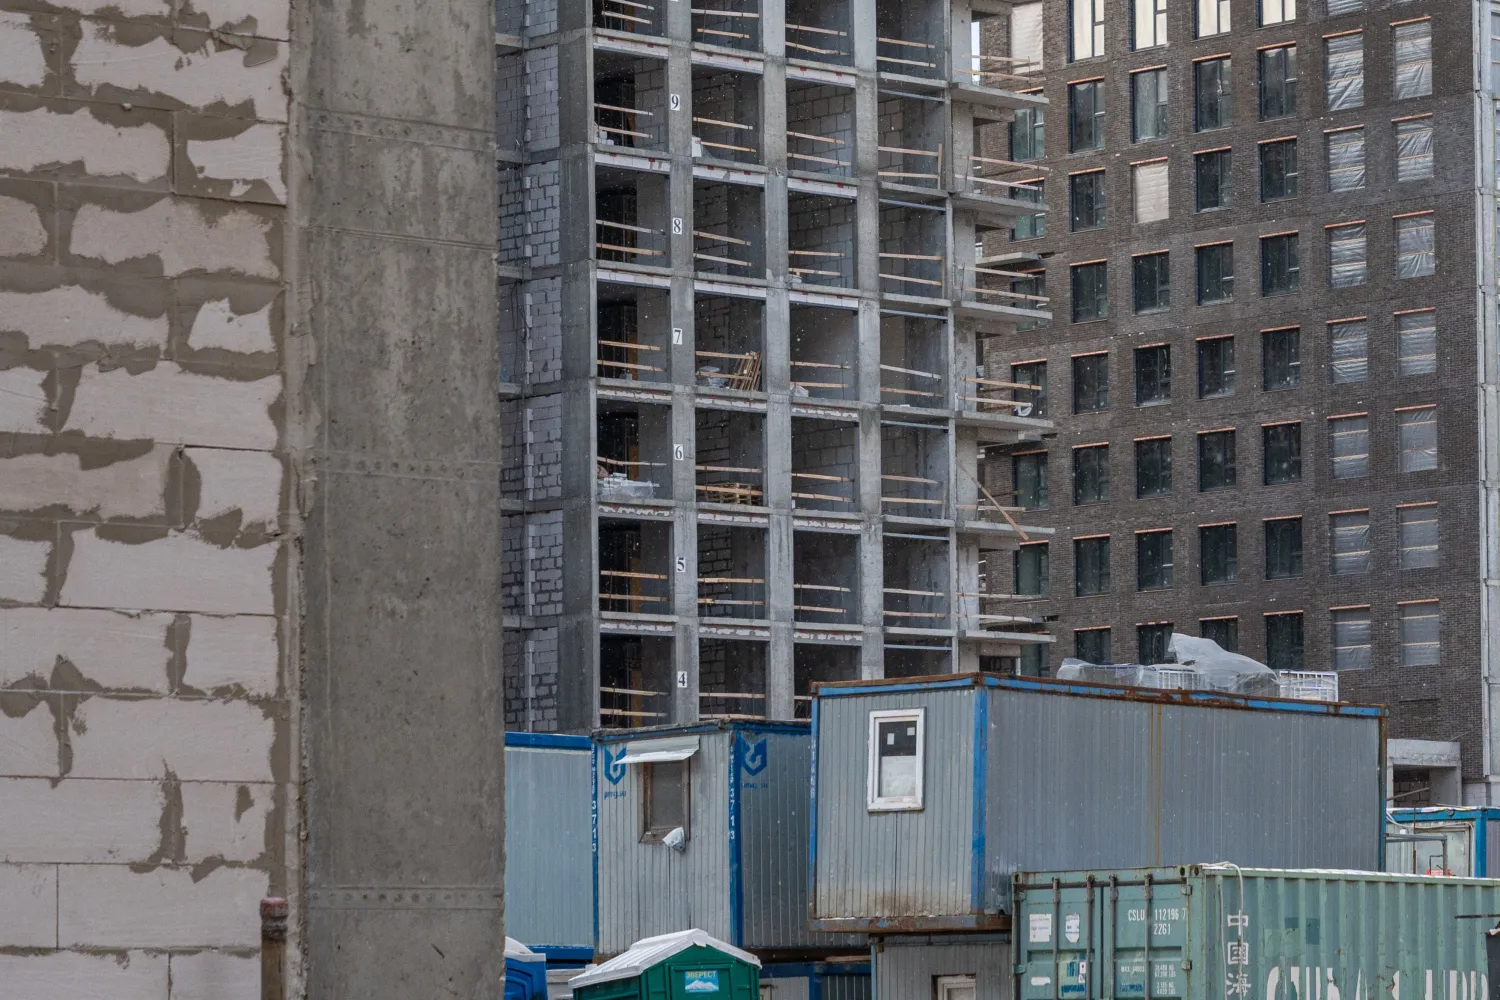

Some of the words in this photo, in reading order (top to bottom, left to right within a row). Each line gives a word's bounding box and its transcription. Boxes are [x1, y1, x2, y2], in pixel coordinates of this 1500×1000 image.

[671, 94, 679, 109] 9
[673, 218, 681, 233] 8
[674, 329, 681, 344] 7
[675, 445, 682, 460] 6
[677, 557, 685, 572] 5
[678, 672, 686, 687] 4
[1128, 909, 1145, 921] CSLU
[1155, 908, 1179, 920] 112196
